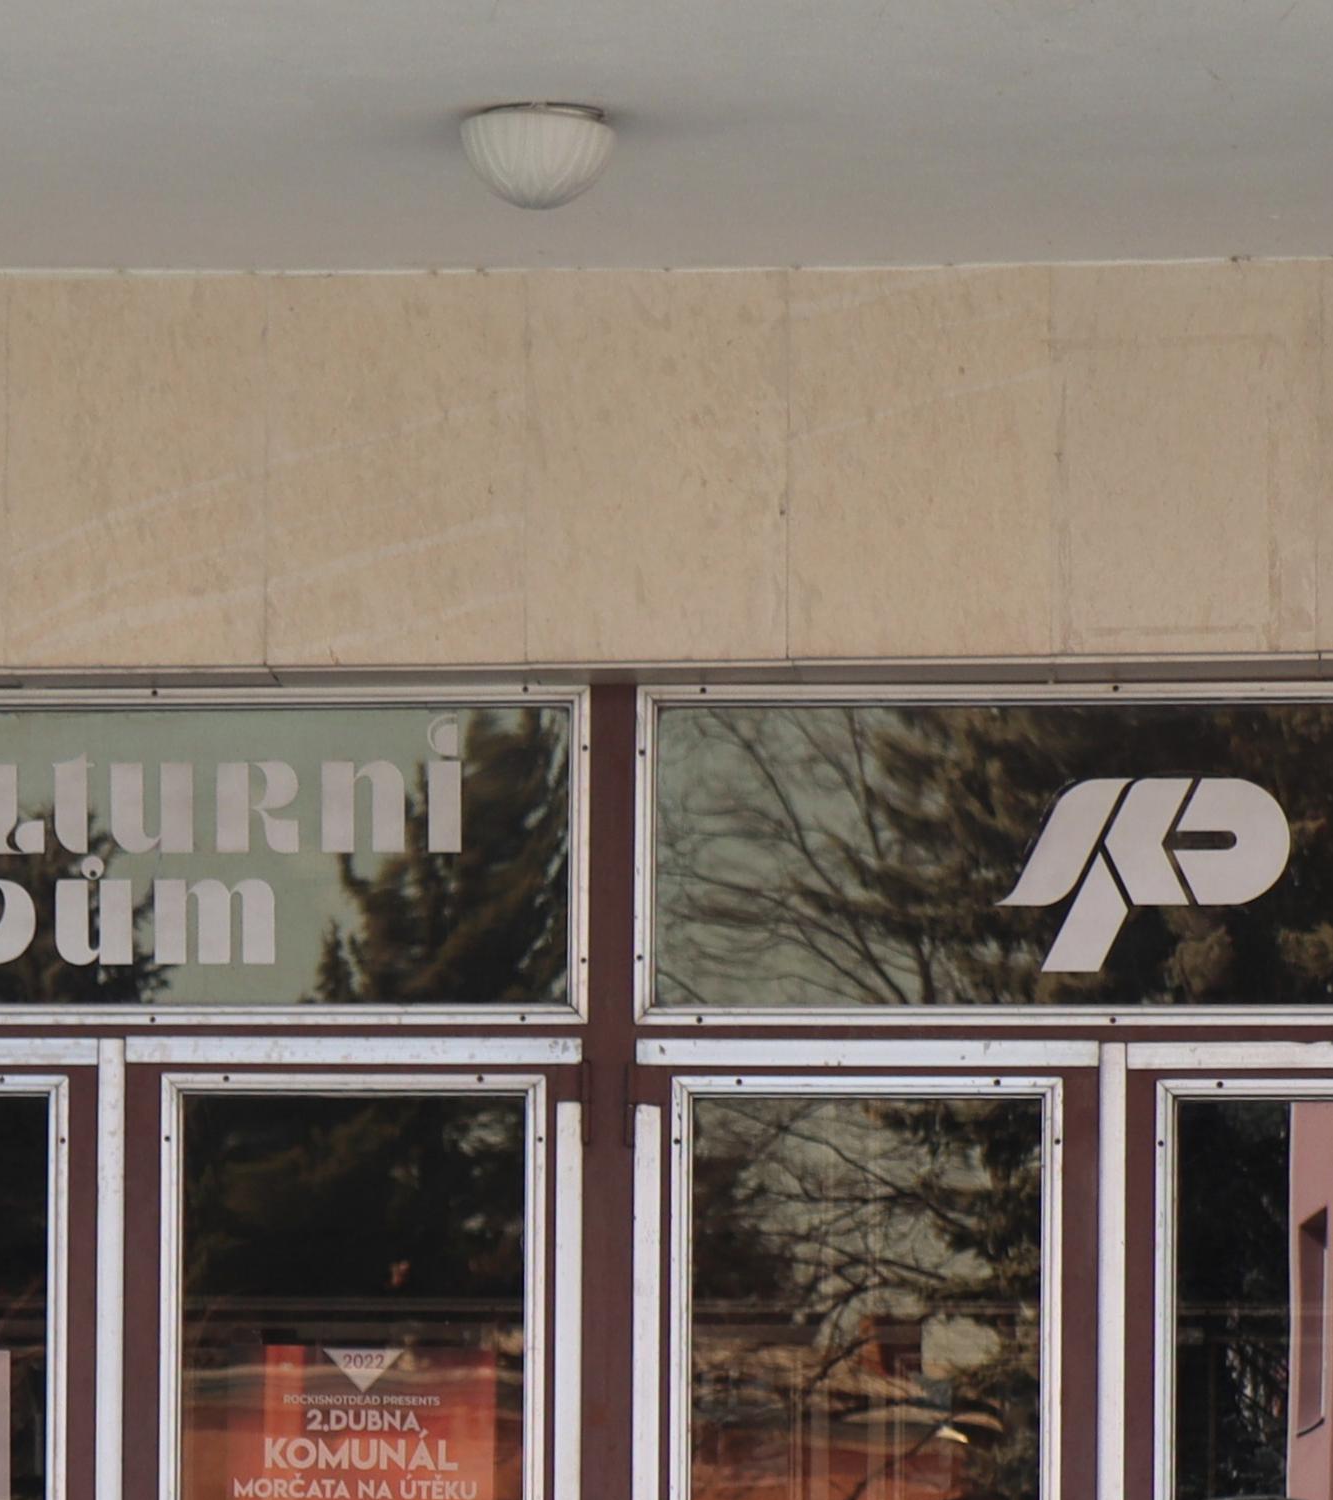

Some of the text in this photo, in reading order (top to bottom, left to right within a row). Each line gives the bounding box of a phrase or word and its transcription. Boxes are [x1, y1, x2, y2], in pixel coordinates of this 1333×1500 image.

[342, 1354, 385, 1370] 2022
[283, 1394, 441, 1407] ROCKISNOTDEAD PRESENTS
[306, 1410, 421, 1432] 2.DUBNA
[264, 1429, 459, 1471] KOMUNÁL
[233, 1472, 477, 1500] MORČATA NA ÚTĚKU
